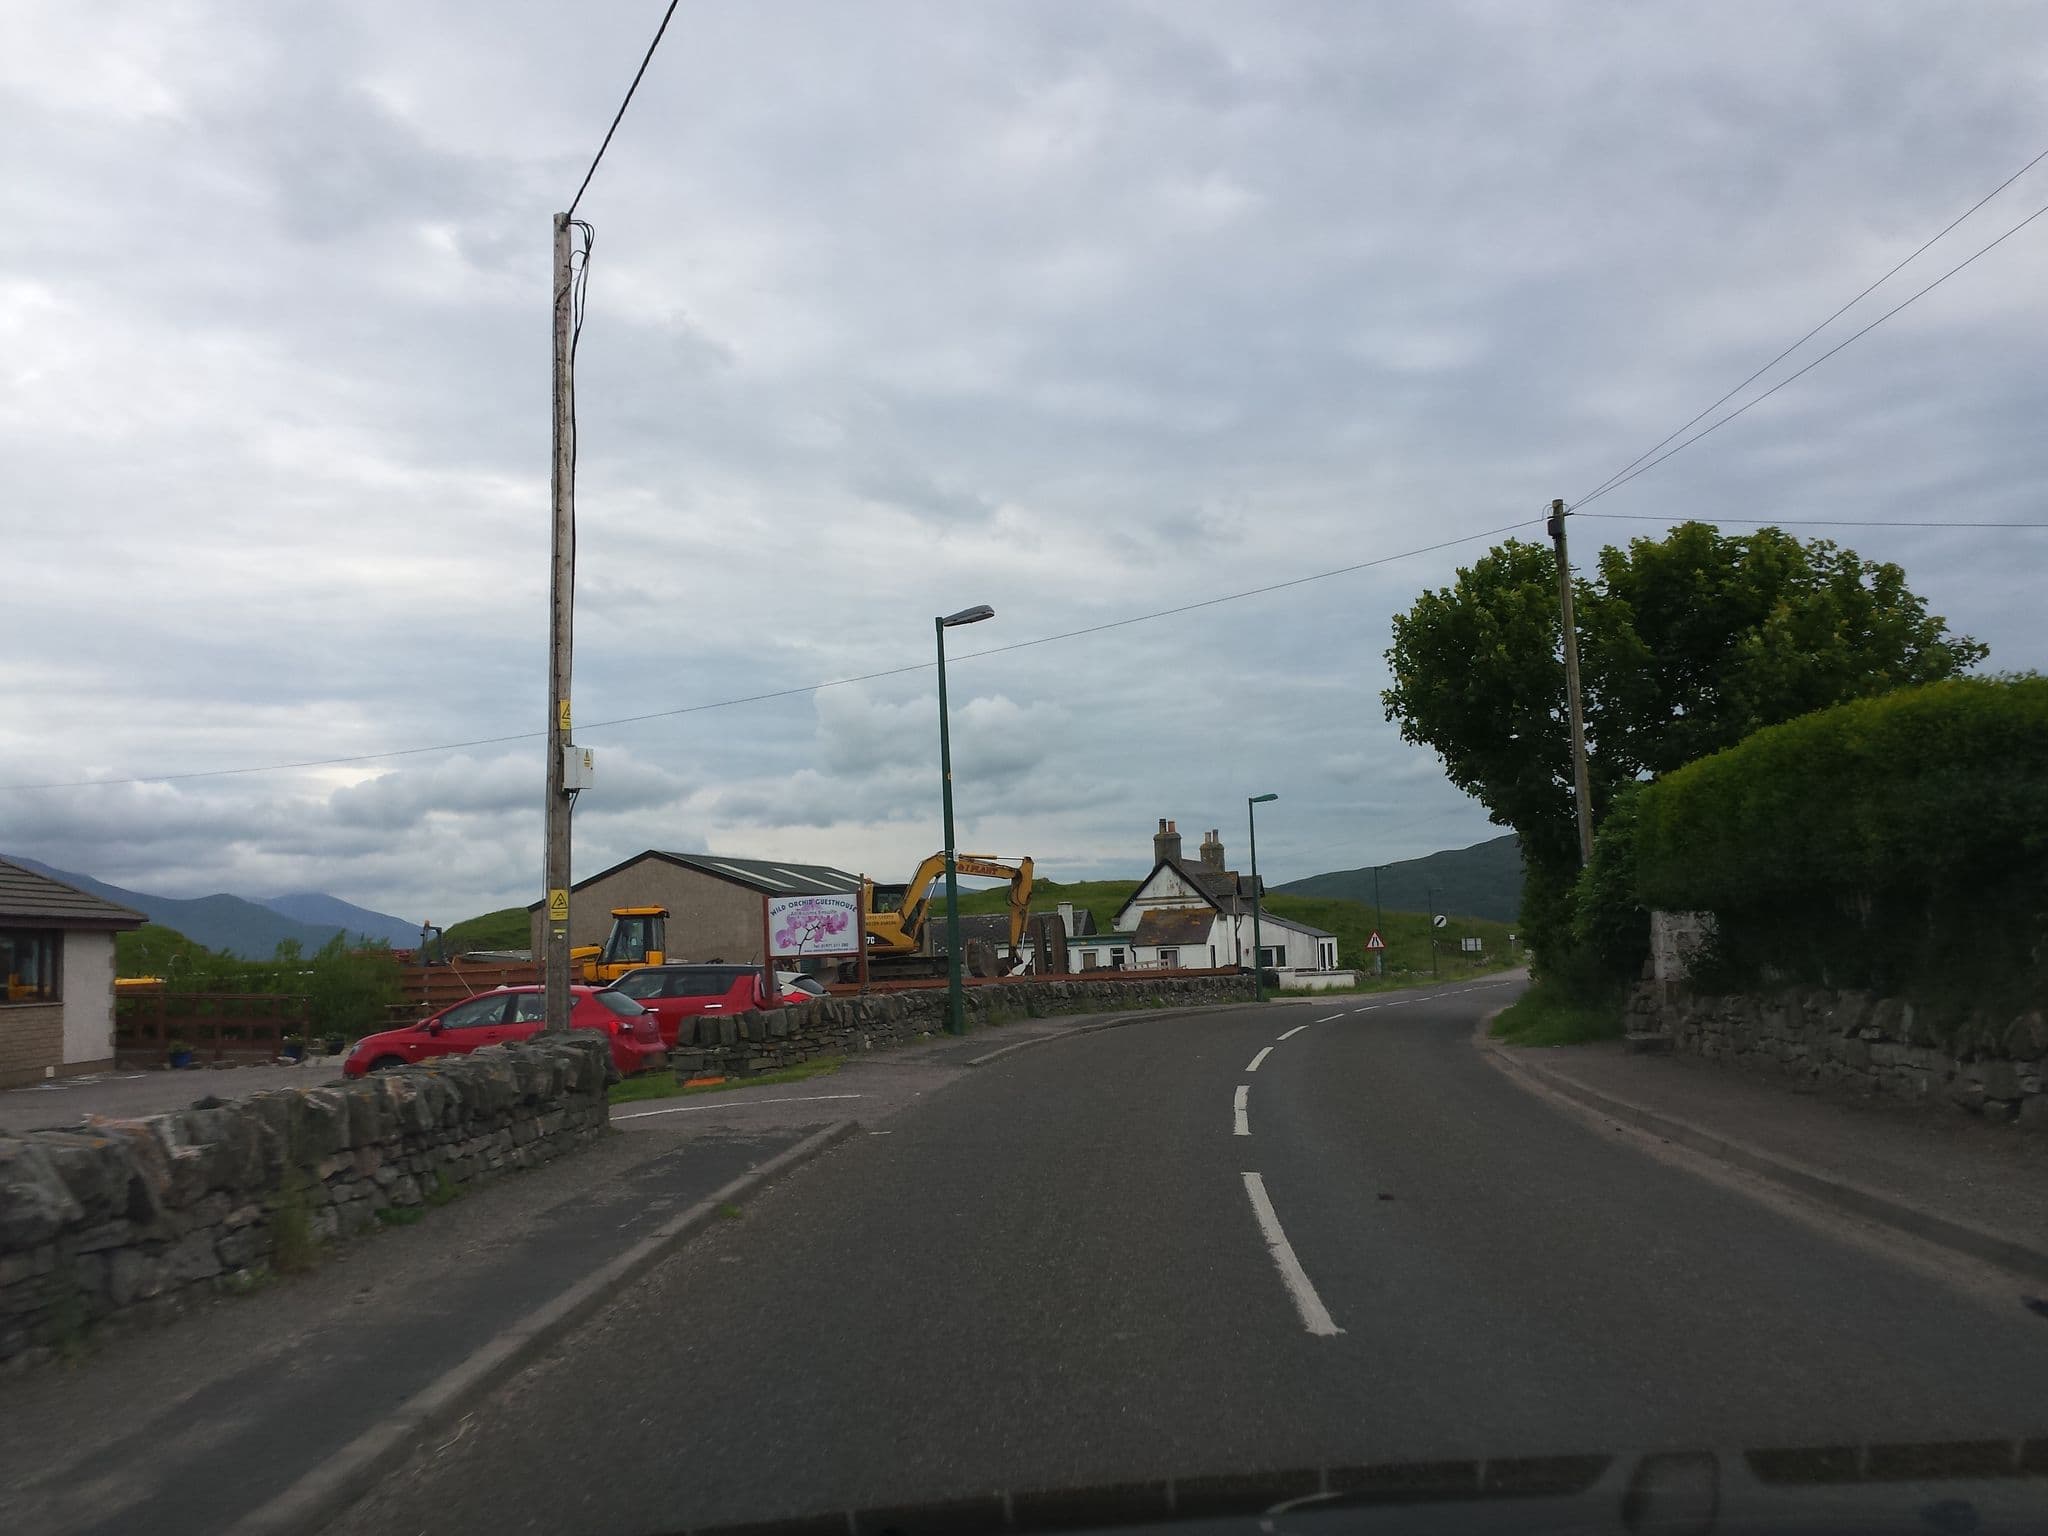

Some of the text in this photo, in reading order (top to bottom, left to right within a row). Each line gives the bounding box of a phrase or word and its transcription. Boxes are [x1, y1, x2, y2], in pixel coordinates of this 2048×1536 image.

[770, 899, 858, 916] WILD ORCHID GUESTHOUSE
